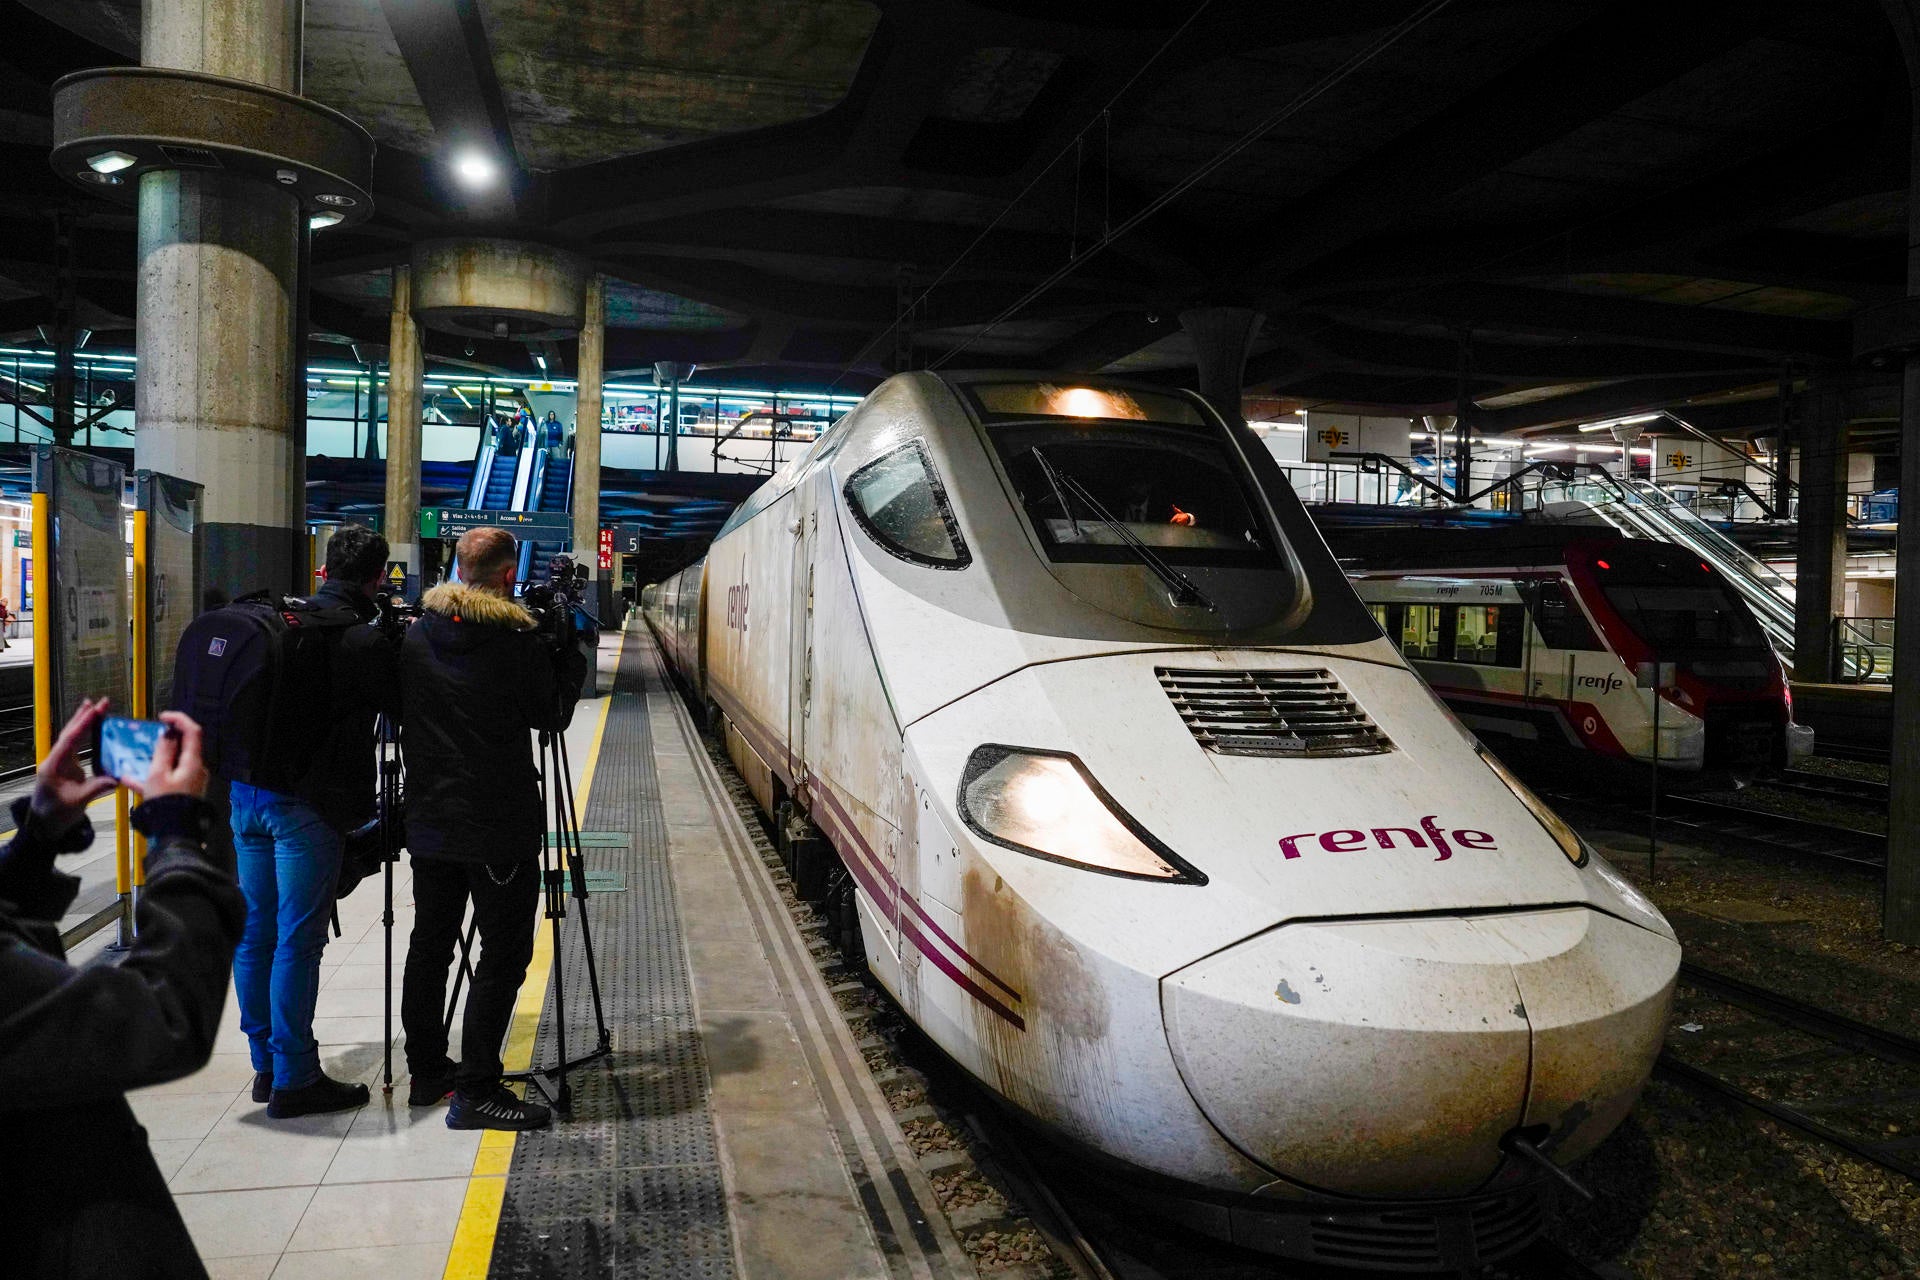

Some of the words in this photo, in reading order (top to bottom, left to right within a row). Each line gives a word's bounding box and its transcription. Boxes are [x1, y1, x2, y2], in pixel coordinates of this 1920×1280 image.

[1317, 430, 1349, 445] FEVE
[1666, 454, 1692, 467] FEVE
[629, 537, 638, 552] 5
[1436, 584, 1460, 597] renfe
[1480, 584, 1503, 596] 705M
[727, 582, 750, 649] renfe
[1577, 672, 1623, 695] renfe
[1278, 815, 1498, 862] renfe
